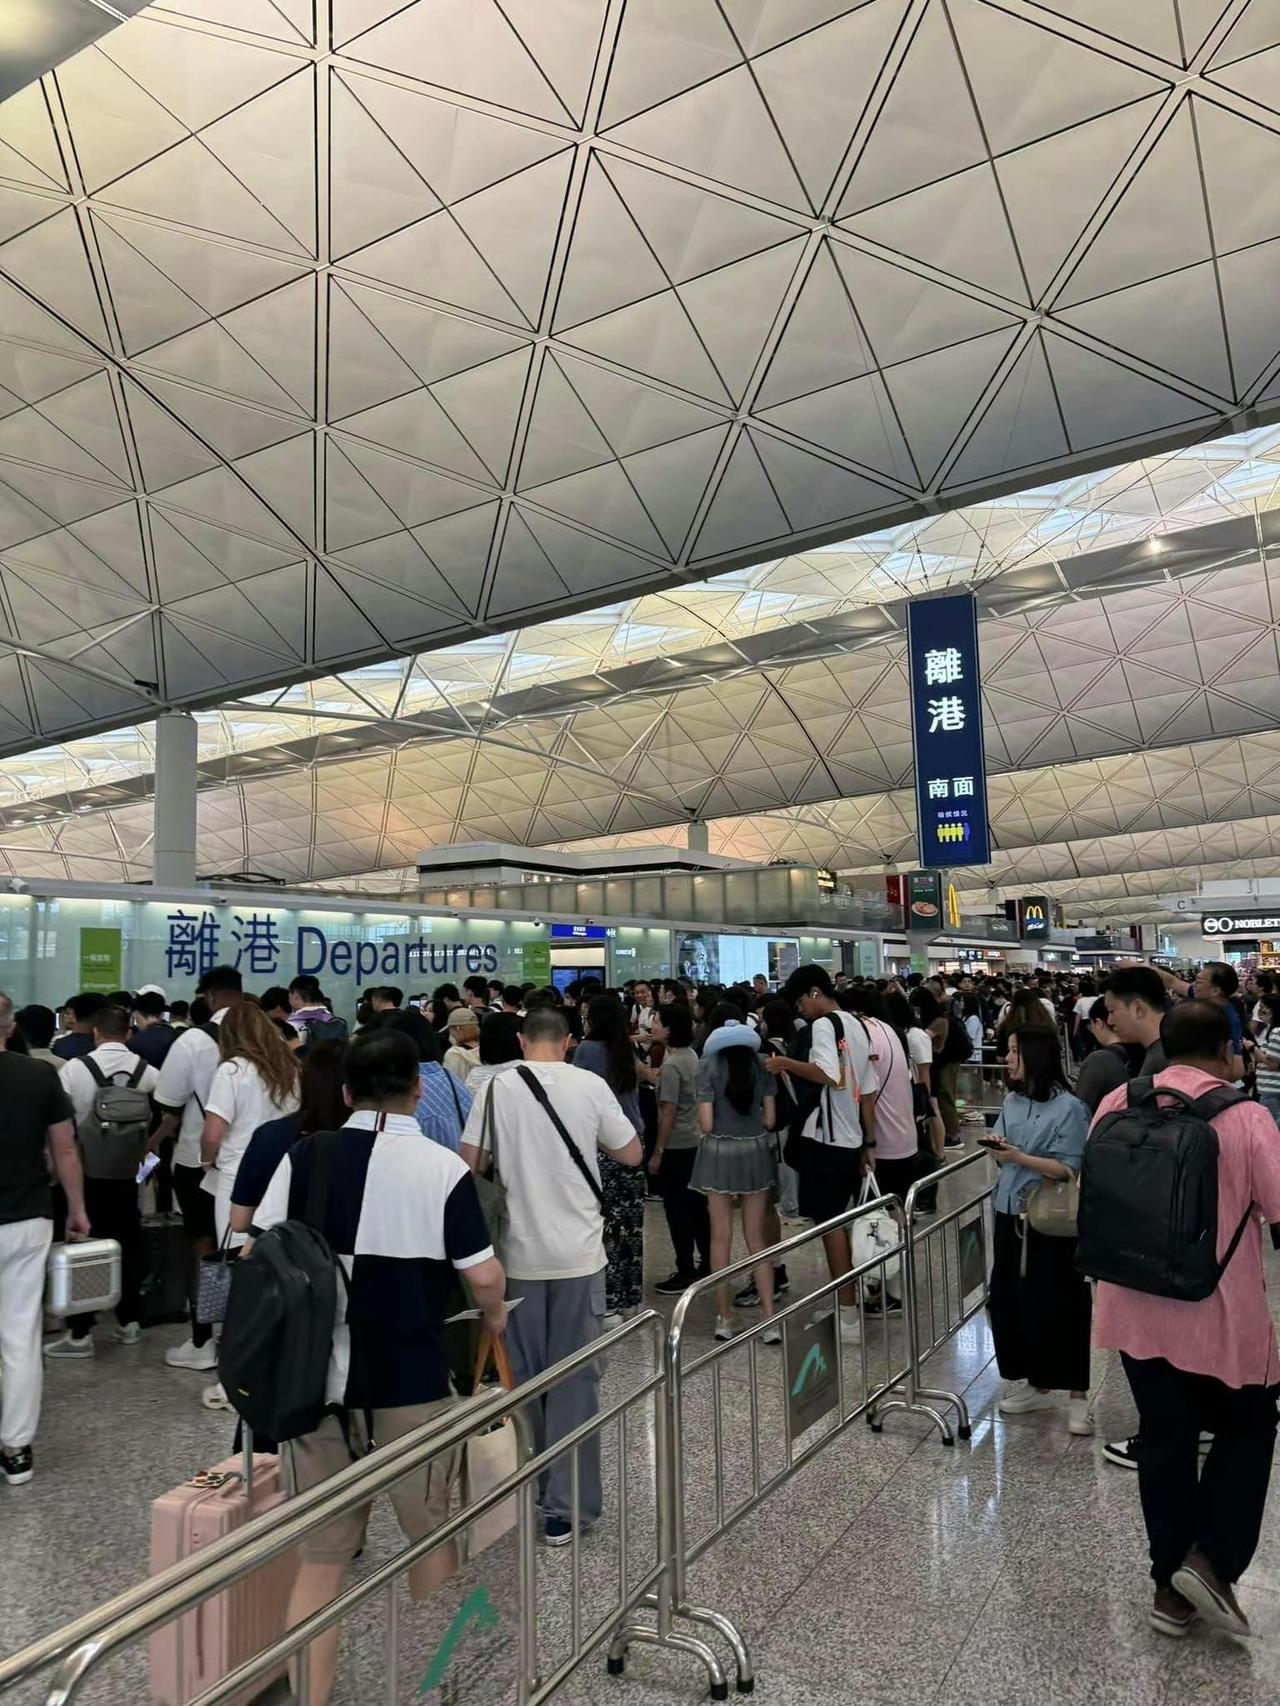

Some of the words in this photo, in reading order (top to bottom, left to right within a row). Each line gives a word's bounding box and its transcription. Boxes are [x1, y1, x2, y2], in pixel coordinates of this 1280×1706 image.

[924, 648, 966, 733] 離港
[927, 776, 974, 799] 南面
[1177, 900, 1186, 910] C
[165, 909, 280, 978] 離港
[297, 926, 498, 985] Departures
